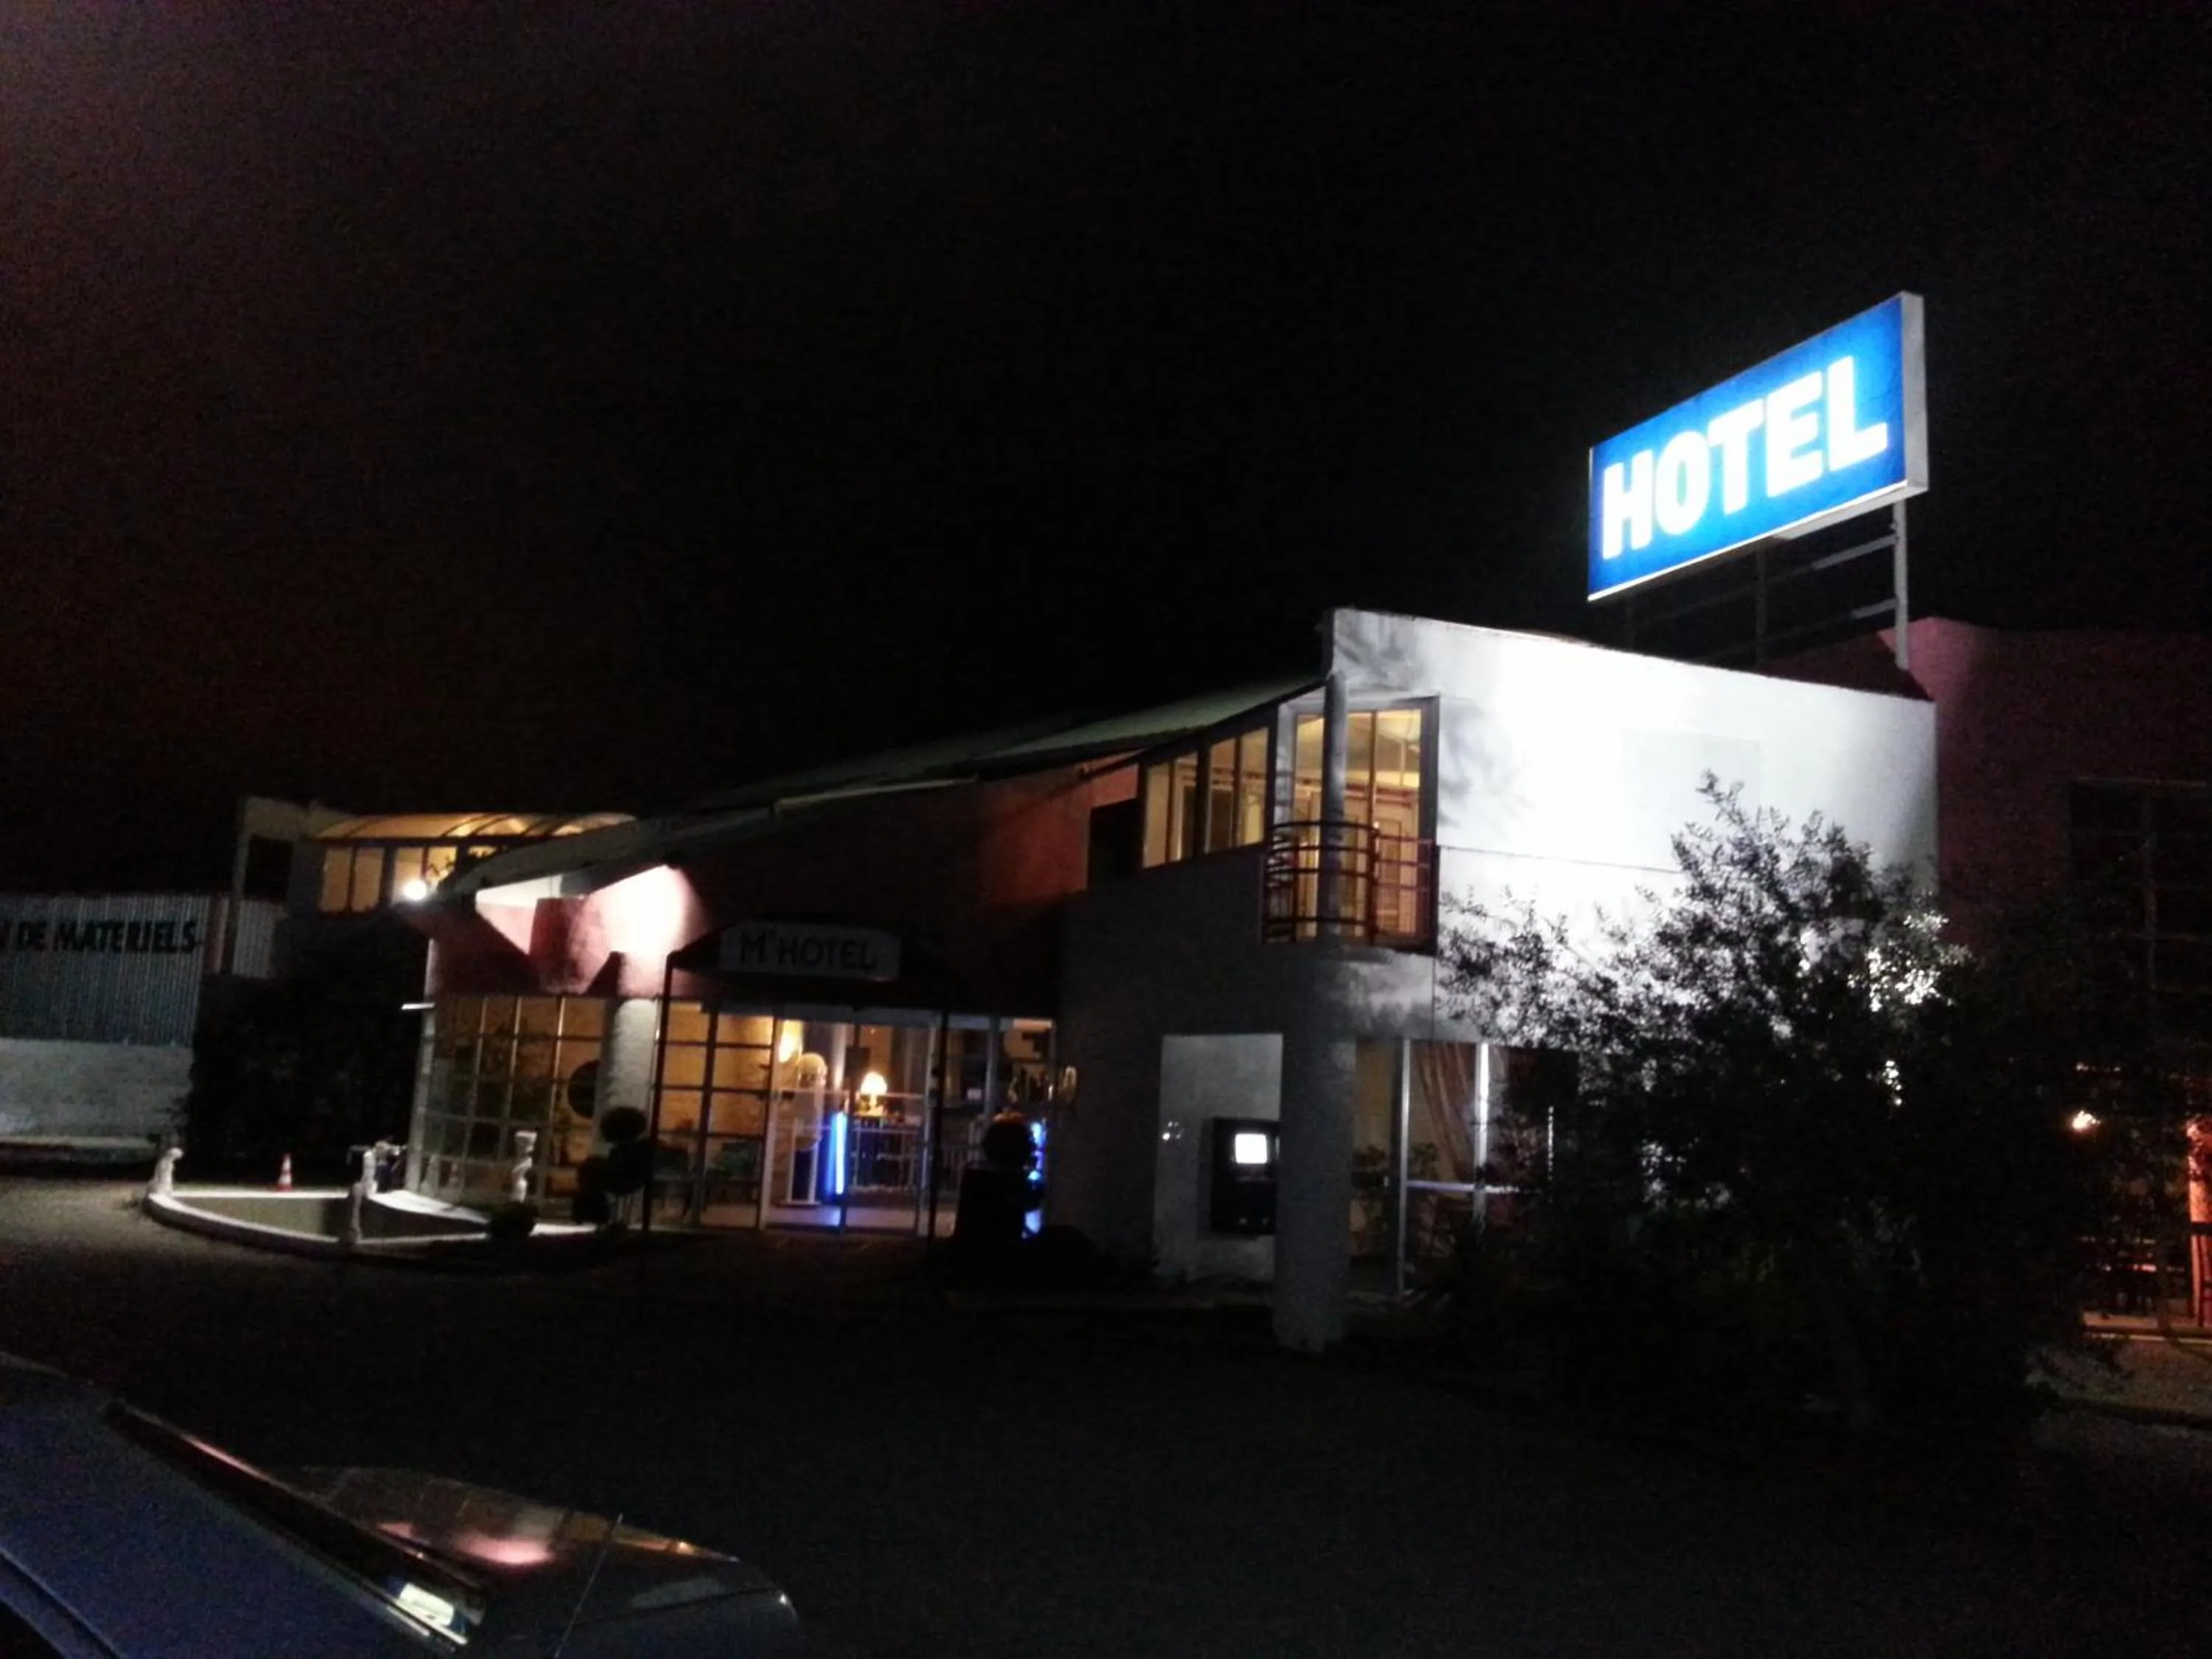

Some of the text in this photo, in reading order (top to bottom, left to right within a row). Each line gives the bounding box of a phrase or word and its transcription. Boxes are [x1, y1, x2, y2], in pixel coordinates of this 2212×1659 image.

[1601, 355, 1888, 560] HOTEL
[18, 919, 47, 952] DE
[54, 919, 197, 953] MATERIELS
